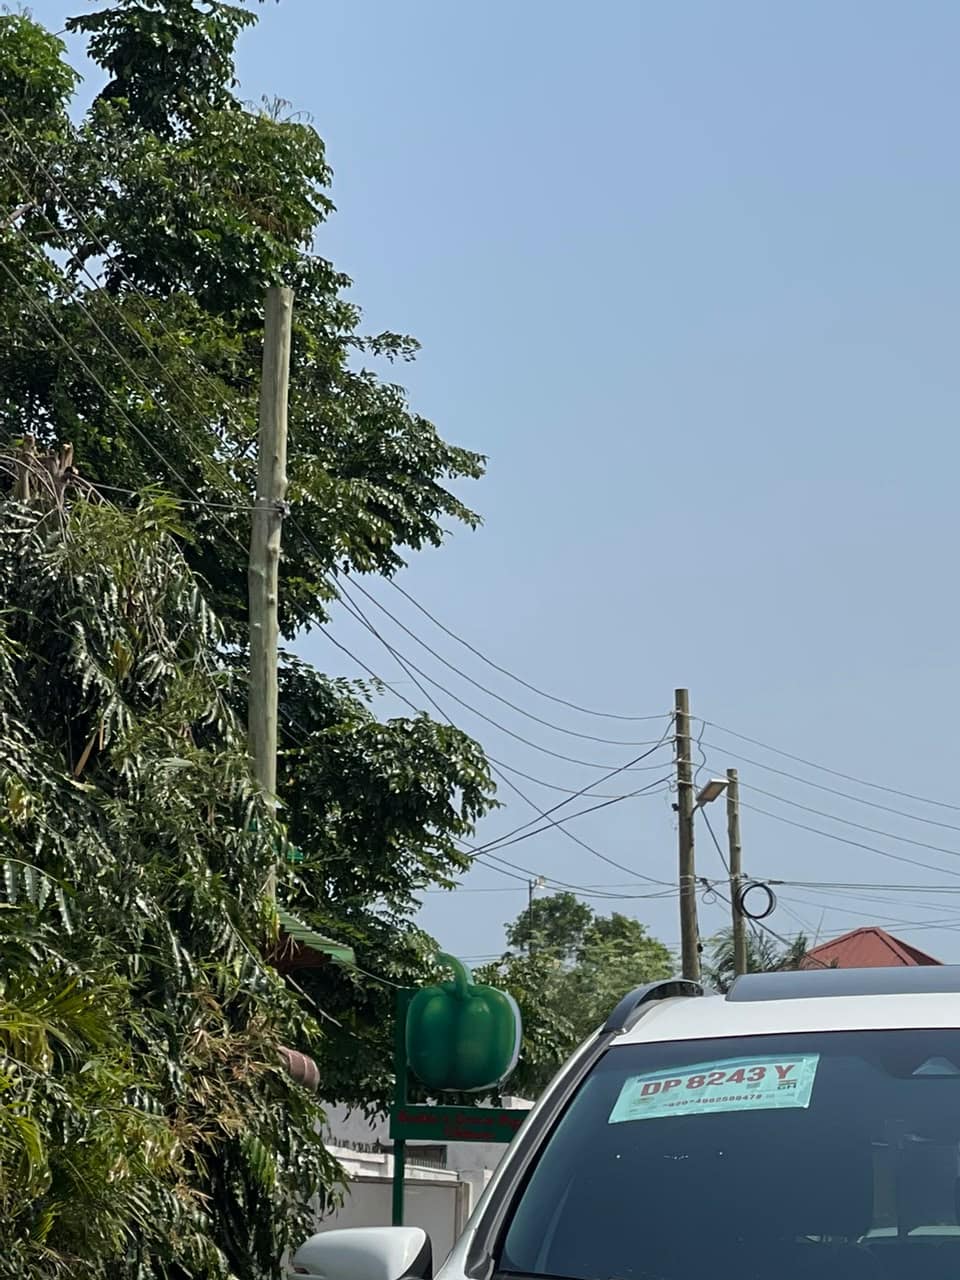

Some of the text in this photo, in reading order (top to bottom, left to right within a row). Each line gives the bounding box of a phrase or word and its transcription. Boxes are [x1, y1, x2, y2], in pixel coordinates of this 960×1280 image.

[641, 1079, 681, 1097] DP
[686, 1067, 766, 1089] 8243
[774, 1065, 795, 1079] Y
